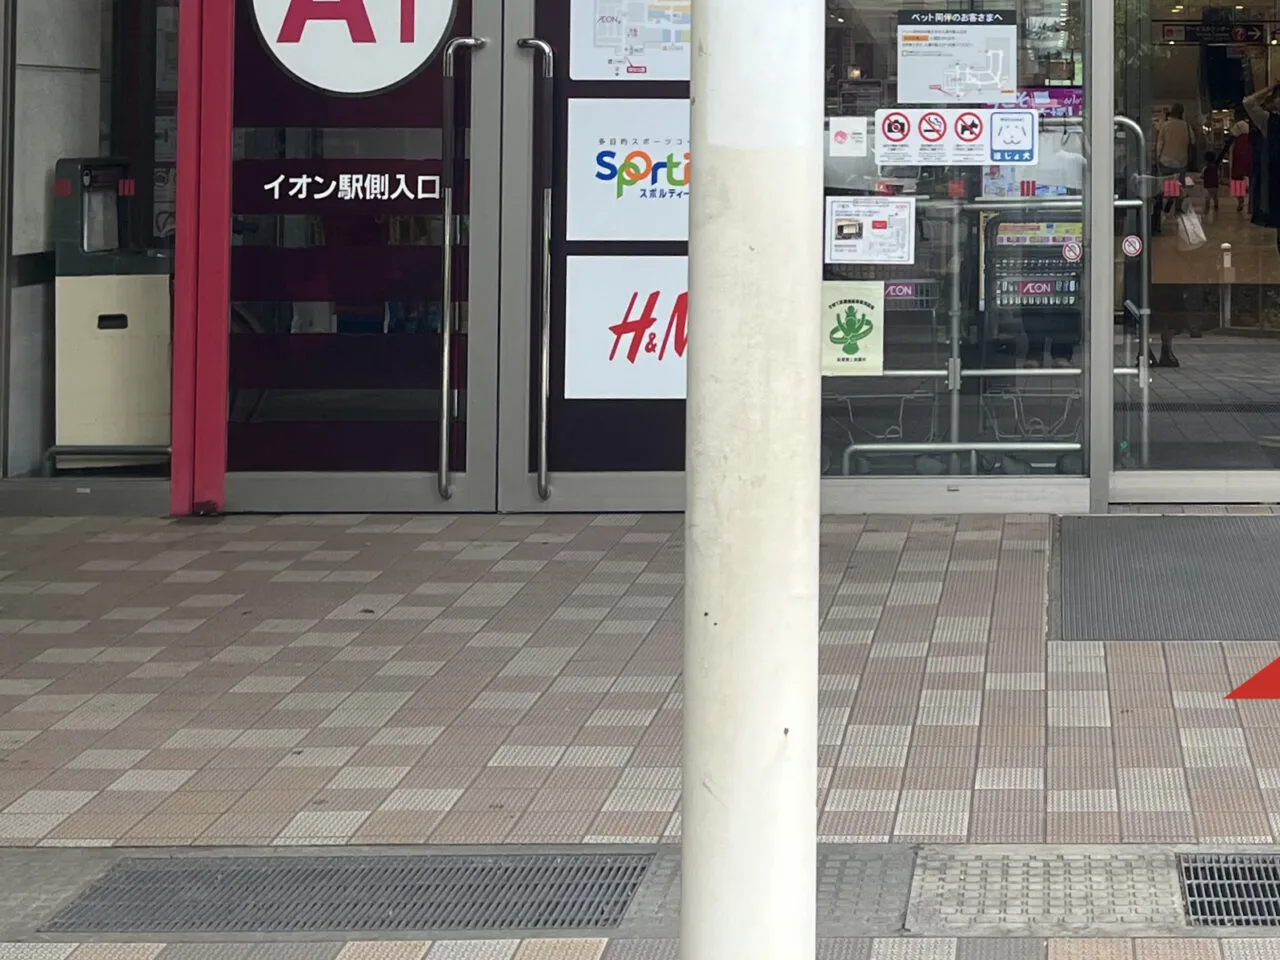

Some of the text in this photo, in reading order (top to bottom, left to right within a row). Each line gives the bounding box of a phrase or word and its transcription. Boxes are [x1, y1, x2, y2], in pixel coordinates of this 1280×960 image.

[911, 12, 1003, 23] ペット同伴のお客さまへ
[263, 173, 441, 200] イオン駅側入口
